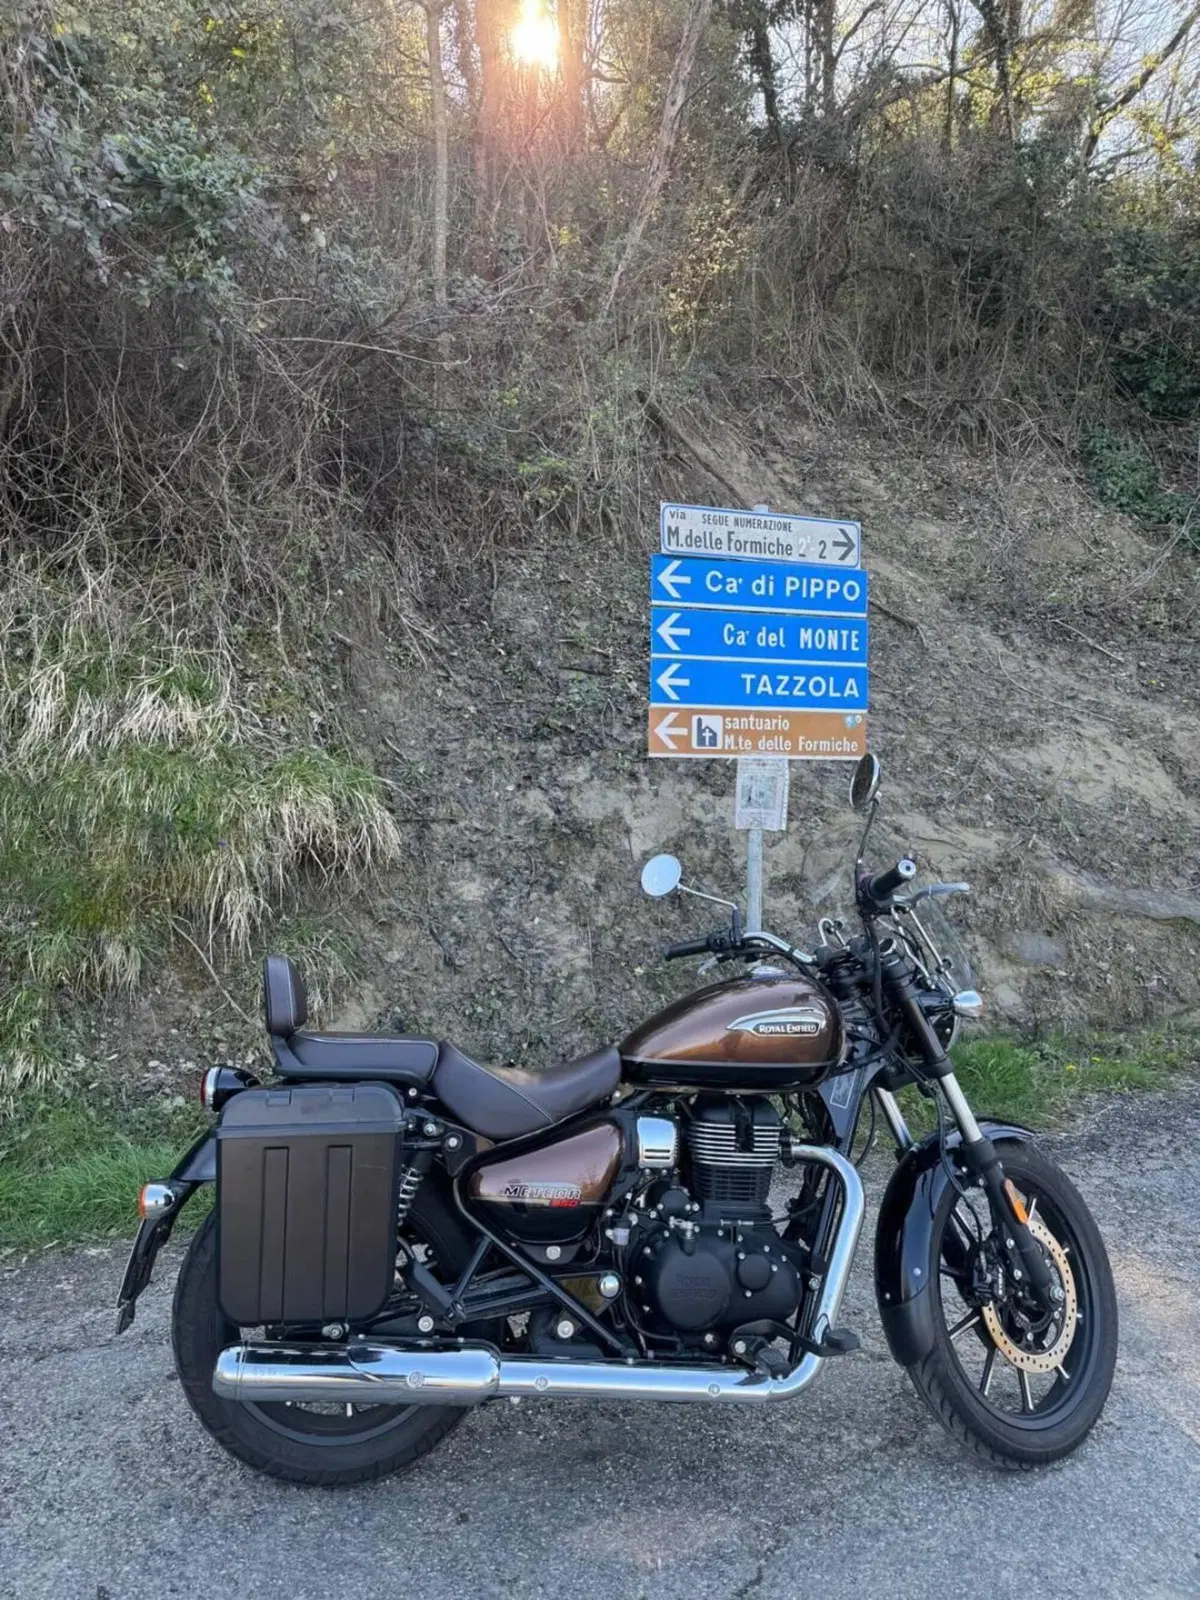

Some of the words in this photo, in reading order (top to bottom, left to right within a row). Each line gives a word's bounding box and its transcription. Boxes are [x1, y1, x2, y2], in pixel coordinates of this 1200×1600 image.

[669, 509, 686, 520] via
[702, 513, 729, 526] SEGUE
[734, 516, 792, 532] NUMERAZIONE
[727, 531, 793, 556] Formiche
[751, 574, 775, 596] di
[785, 576, 861, 602] PIPPO
[756, 626, 786, 648] del
[800, 627, 860, 651] MONTE
[740, 673, 860, 698] TAZZOLA
[724, 714, 790, 731] santuario
[724, 734, 753, 750] M.te
[758, 734, 792, 751] delle
[798, 735, 858, 752] Formiche
[759, 1023, 785, 1033] ROYAL
[503, 1184, 581, 1199] METEOR
